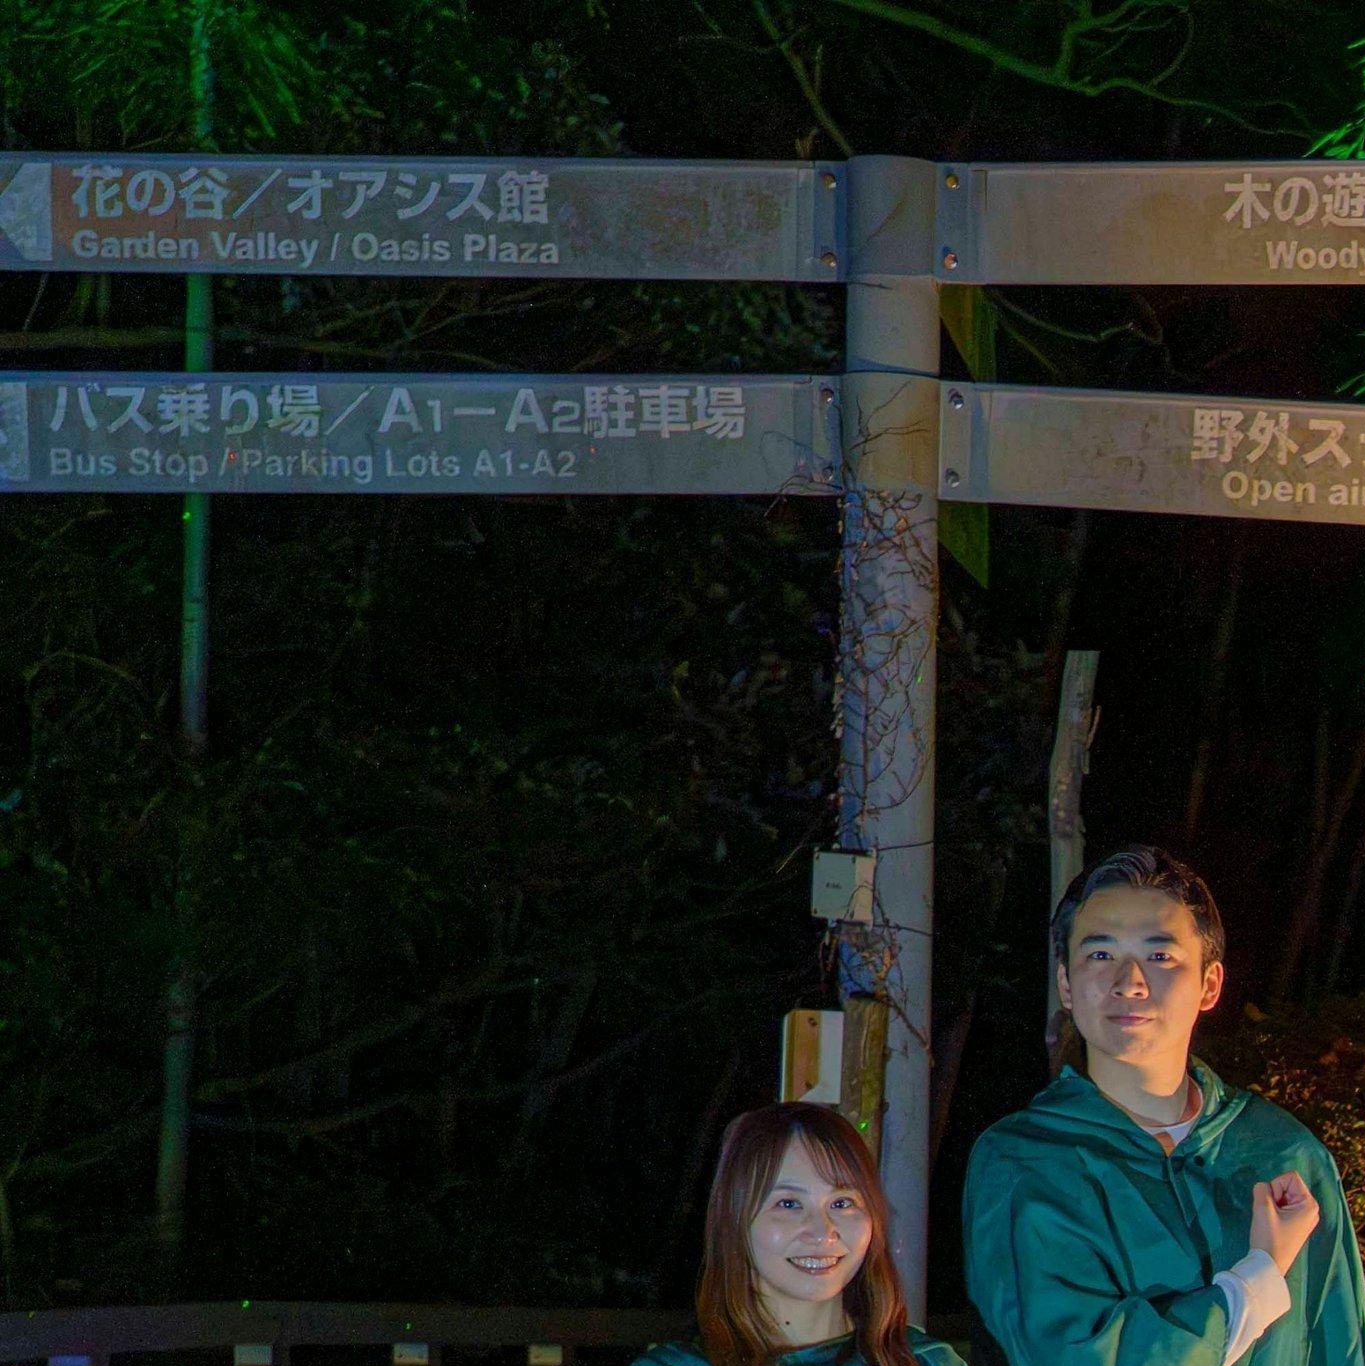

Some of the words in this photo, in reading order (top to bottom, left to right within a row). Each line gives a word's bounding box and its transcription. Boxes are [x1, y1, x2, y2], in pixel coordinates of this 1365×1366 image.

[72, 164, 549, 225] 花の谷／オアシス館
[72, 229, 200, 259] Garden
[209, 232, 319, 269] Valley
[352, 232, 451, 262] Oasis
[464, 233, 560, 264] Plaza
[50, 449, 117, 476] Bus
[128, 448, 209, 483] Stop
[242, 449, 374, 484] Parking
[385, 449, 460, 477] Lots
[473, 450, 577, 478] A1-A2
[1222, 471, 1317, 505] Open
